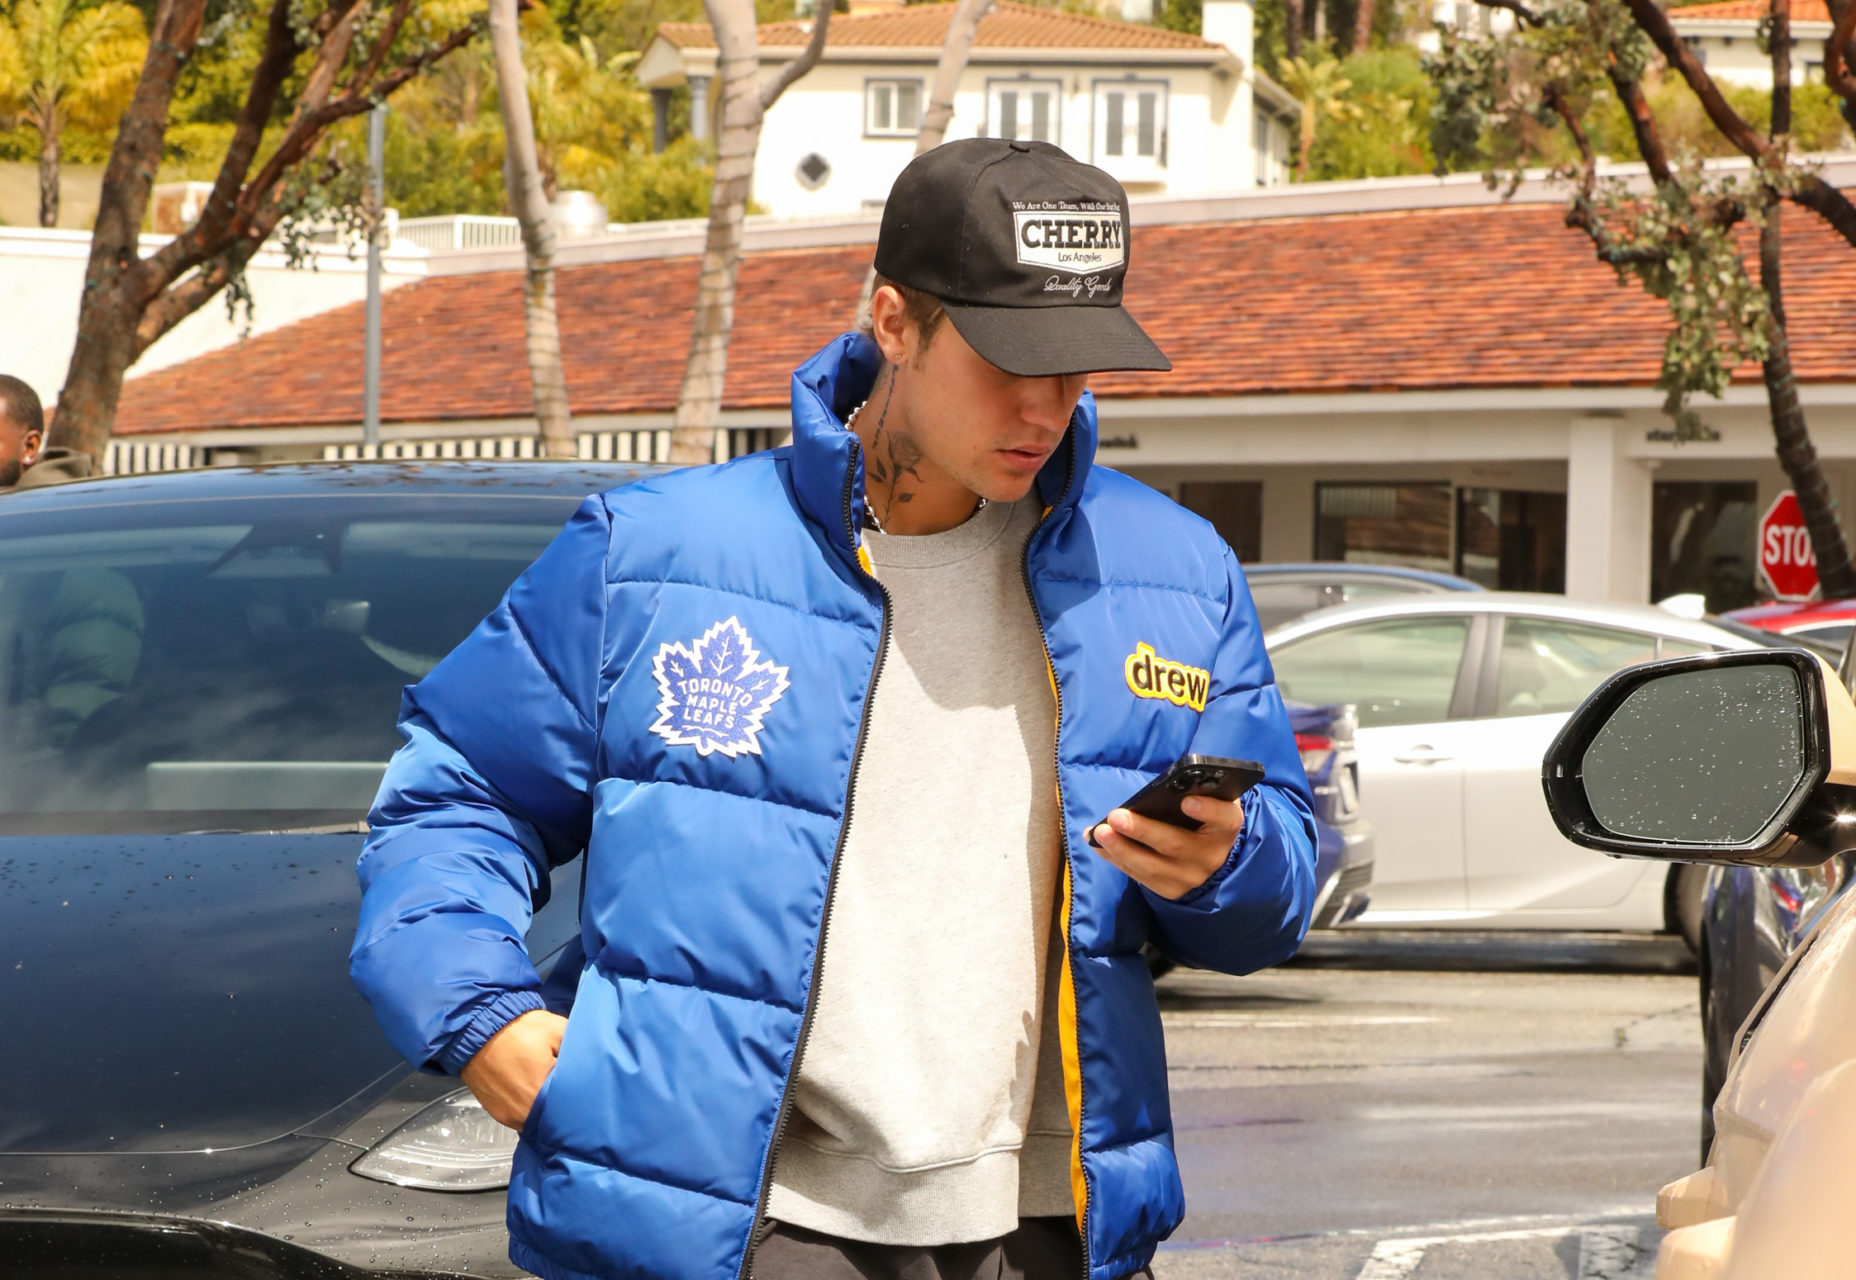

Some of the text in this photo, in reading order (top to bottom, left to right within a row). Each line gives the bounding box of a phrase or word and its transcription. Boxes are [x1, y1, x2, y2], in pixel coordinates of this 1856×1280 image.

[1012, 201, 1026, 210] We
[1027, 202, 1041, 210] Are
[1042, 201, 1057, 210] One
[1021, 219, 1121, 249] CHERRY
[1058, 251, 1102, 264] Los Angeles
[1043, 275, 1083, 298] Quality
[1764, 524, 1817, 567] STO
[1132, 653, 1206, 705] drew
[677, 677, 753, 707] TORONTO
[686, 693, 738, 715] MAPLE
[683, 707, 736, 729] LEAFS
